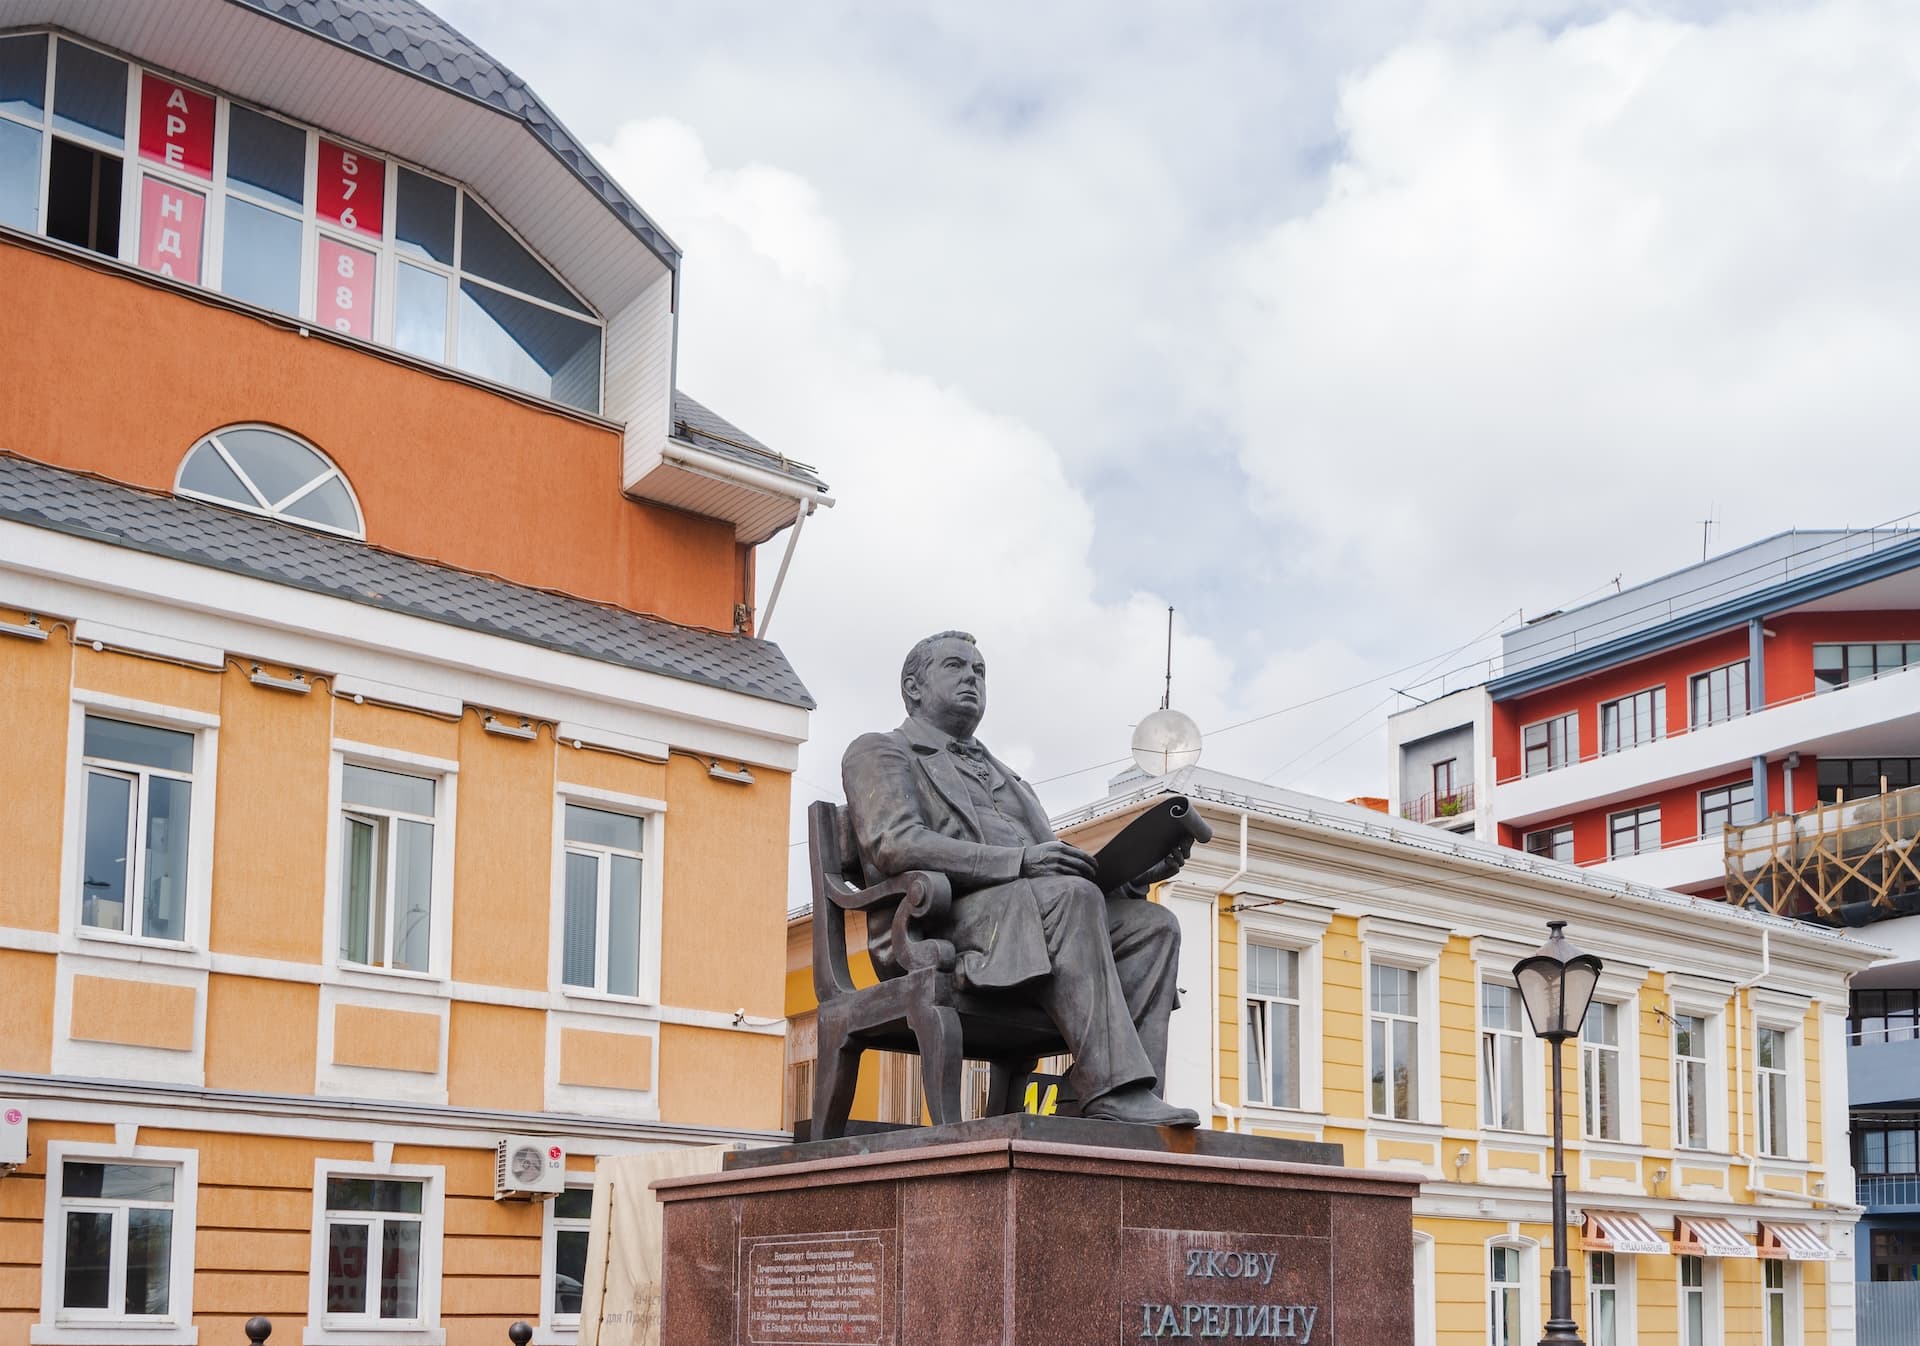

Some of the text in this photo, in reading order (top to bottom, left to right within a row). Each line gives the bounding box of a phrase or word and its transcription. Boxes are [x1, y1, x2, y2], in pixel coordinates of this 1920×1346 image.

[549, 1161, 560, 1169] LG
[816, 1263, 836, 1273] города
[1186, 1249, 1279, 1286] ЯКОВУ
[1140, 1303, 1319, 1346] ГАРЕЛИНУ
